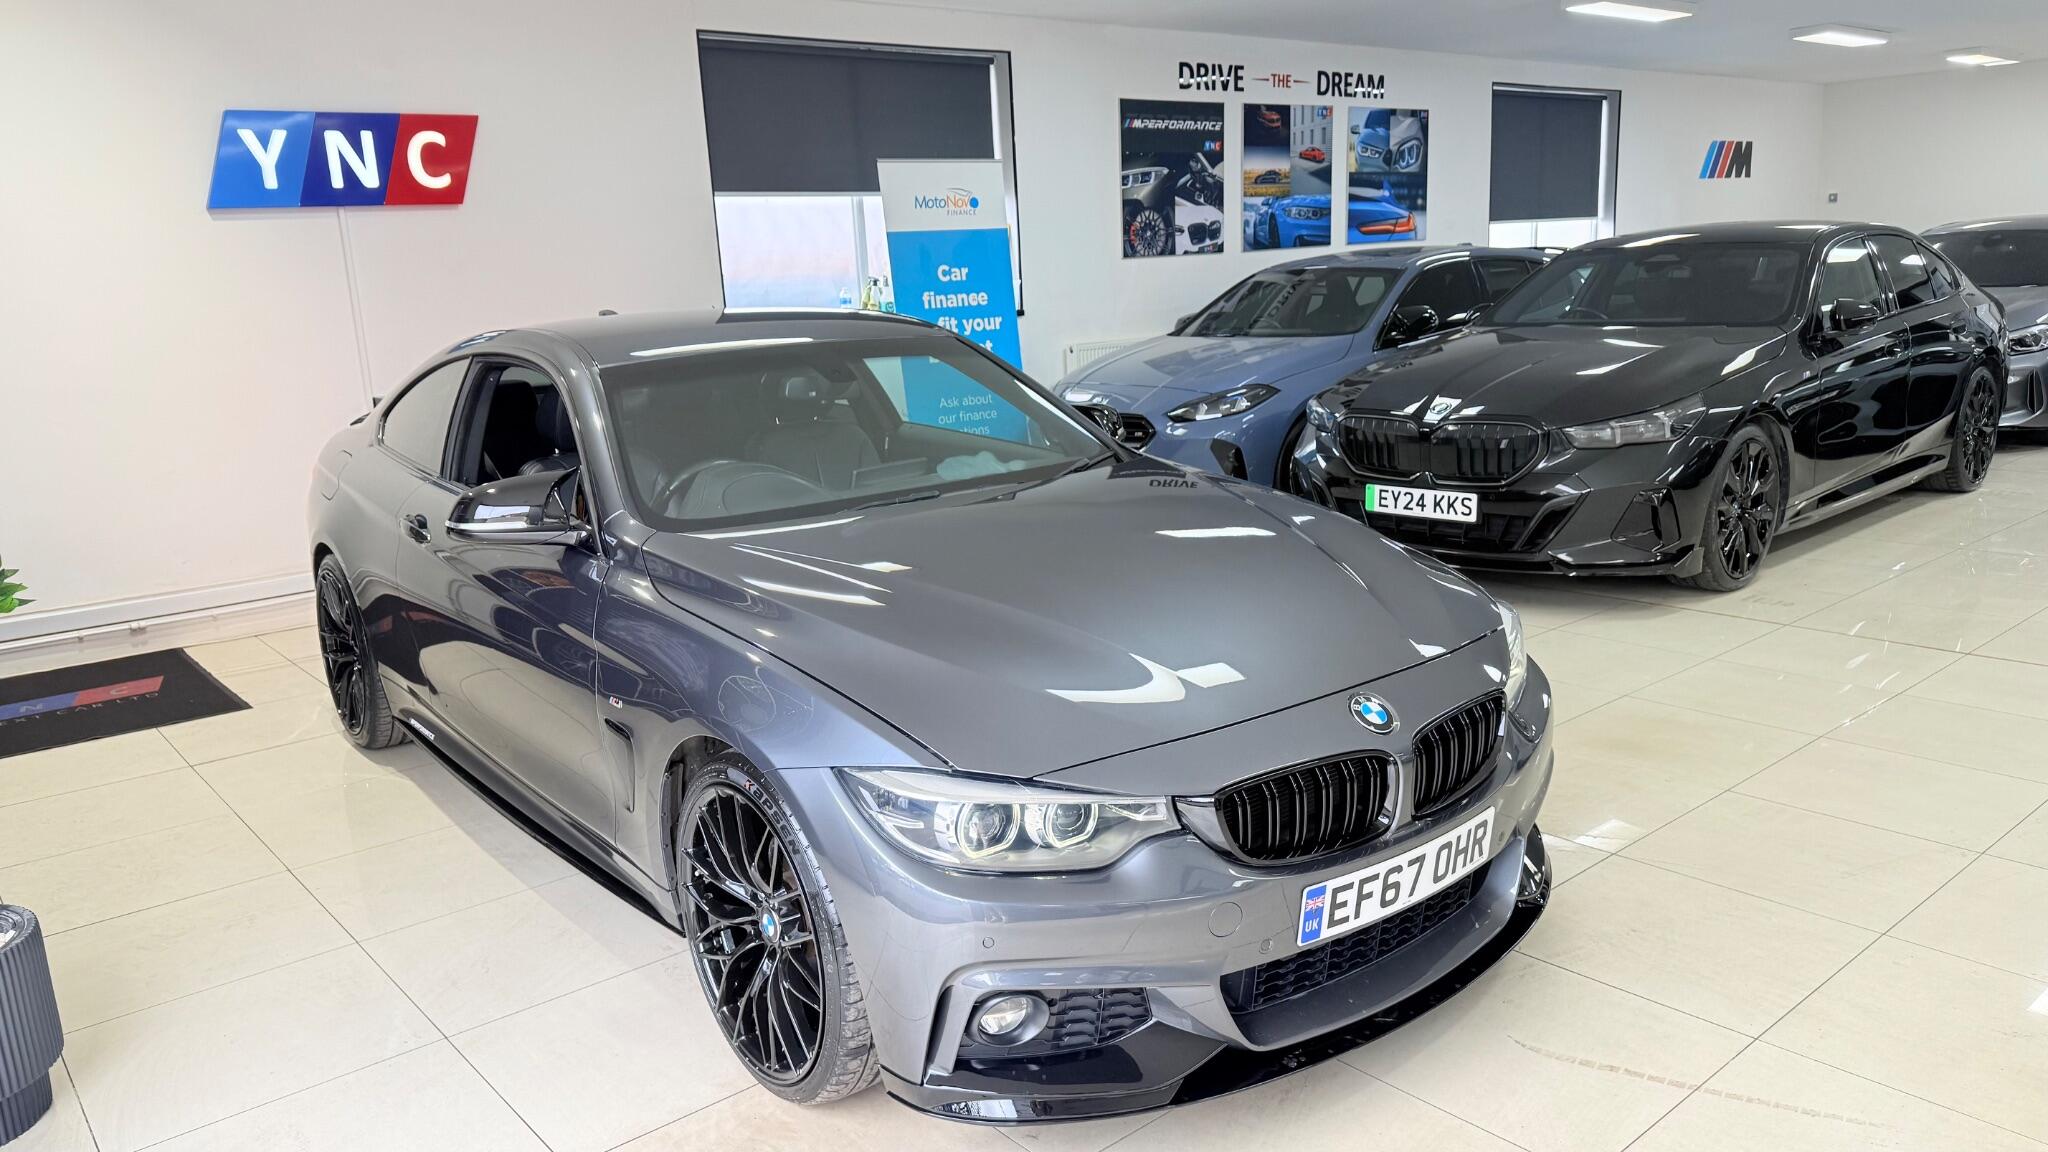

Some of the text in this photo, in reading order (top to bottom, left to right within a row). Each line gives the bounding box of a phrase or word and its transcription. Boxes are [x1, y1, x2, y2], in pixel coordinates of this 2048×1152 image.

[1178, 61, 1386, 99] DRIVE THE DREAM
[236, 128, 452, 190] YNC
[946, 208, 977, 216] FINANCE
[937, 264, 968, 282] Car
[922, 290, 989, 310] finance
[962, 316, 1003, 336] your
[940, 393, 993, 409] Ask about
[938, 409, 998, 425] our finance
[1378, 488, 1473, 517] EY24 KKS
[1327, 818, 1488, 930] EF67 OHR
[1304, 917, 1320, 933] UK
